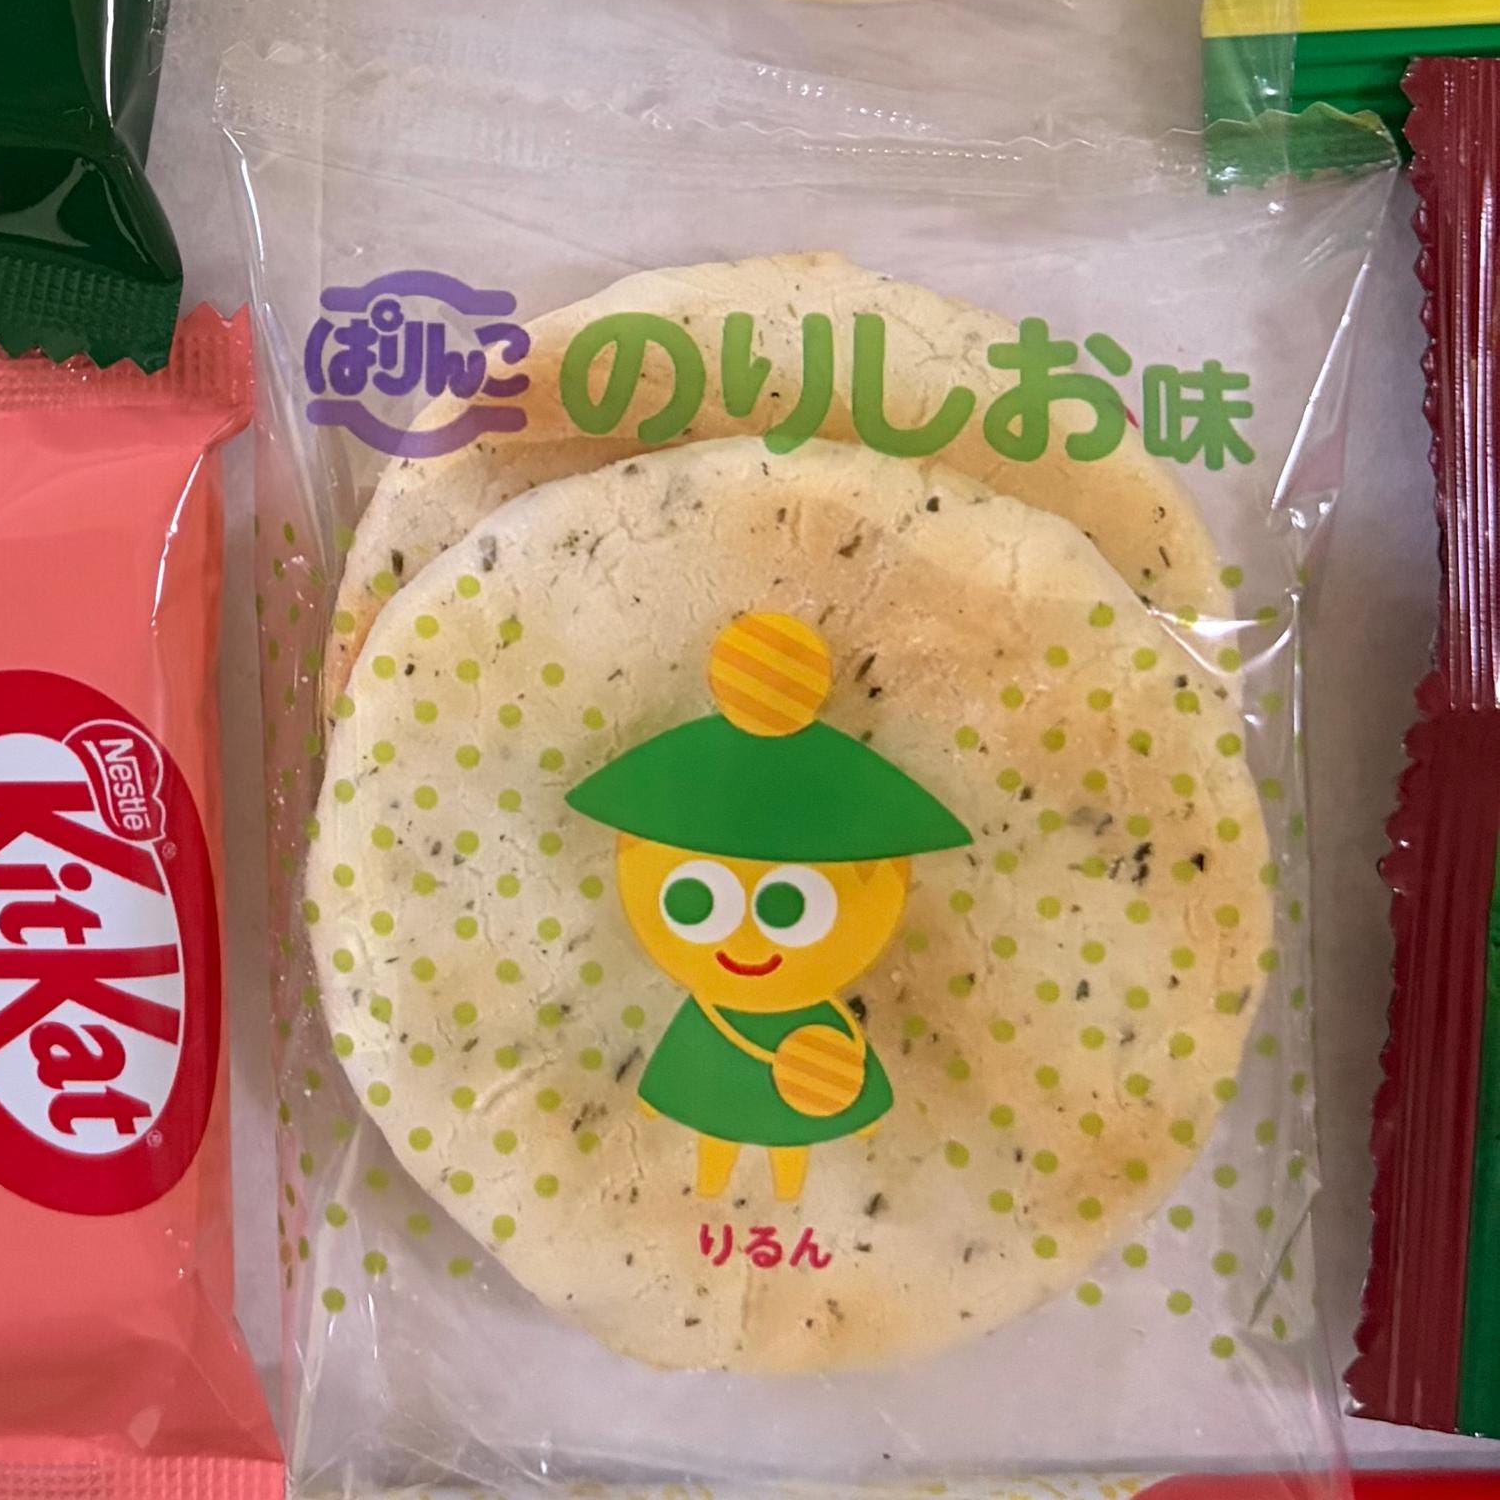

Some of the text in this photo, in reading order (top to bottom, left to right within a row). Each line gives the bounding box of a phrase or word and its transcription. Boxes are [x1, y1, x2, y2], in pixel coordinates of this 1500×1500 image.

[303, 300, 531, 398] ぱりんこ
[558, 310, 1256, 472] のりしお味
[699, 1223, 833, 1269] りるん
